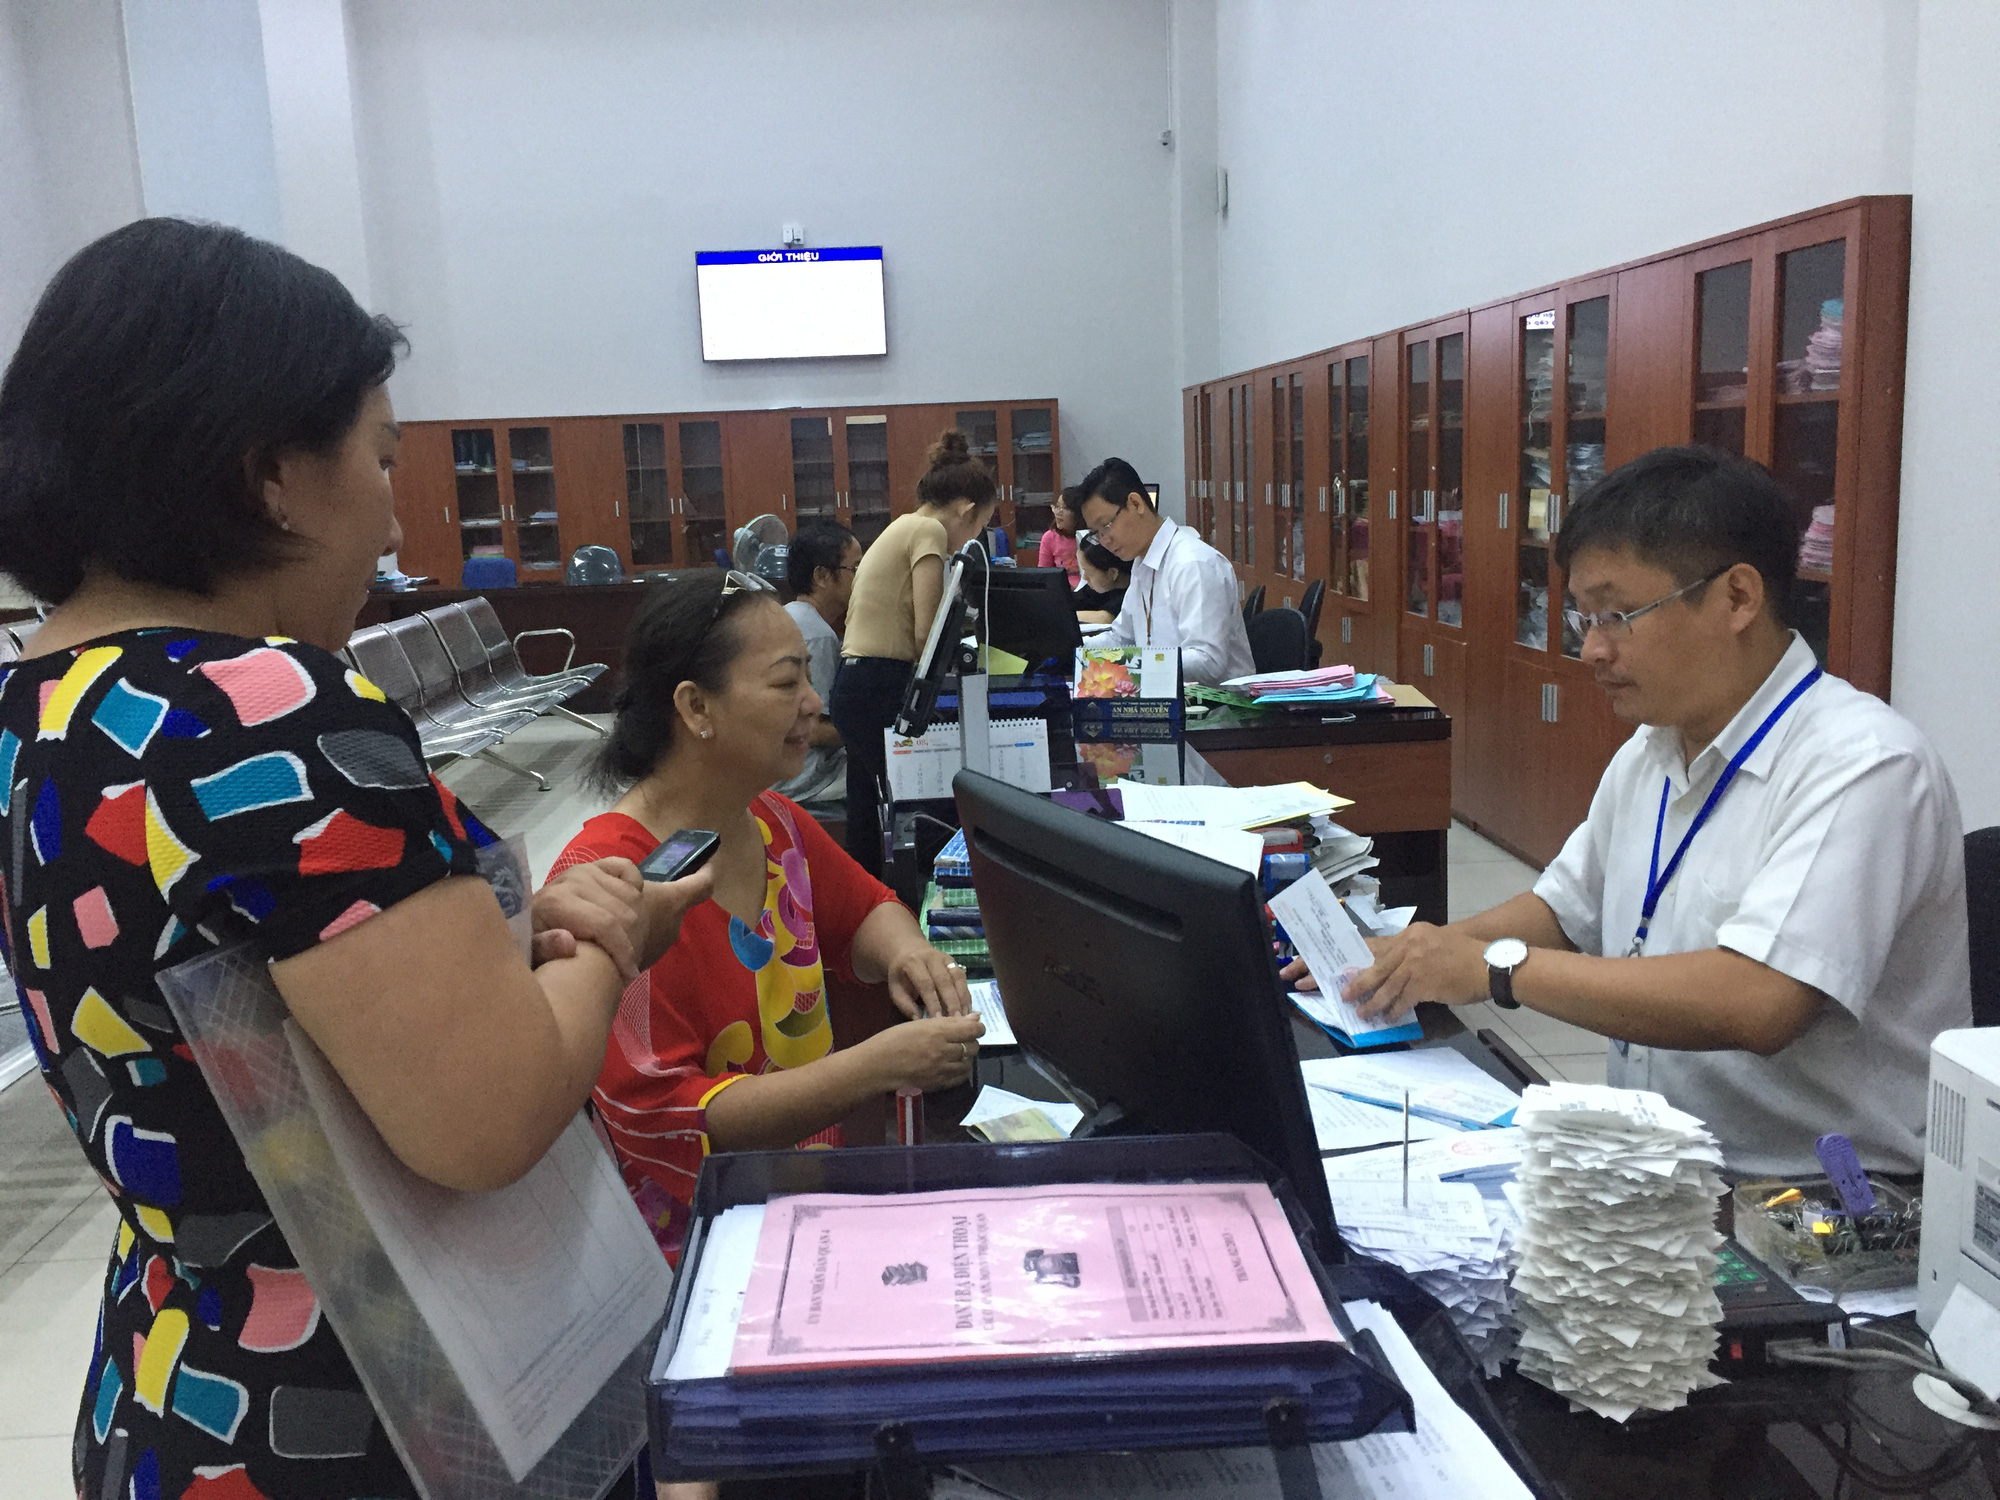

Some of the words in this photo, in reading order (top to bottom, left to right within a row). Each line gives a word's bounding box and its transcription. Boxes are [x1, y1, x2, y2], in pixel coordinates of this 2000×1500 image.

[758, 251, 783, 262] GIỚI
[785, 251, 819, 262] THIỆU
[952, 1216, 972, 1250] THOẠI
[952, 1252, 974, 1279] ĐIỆN
